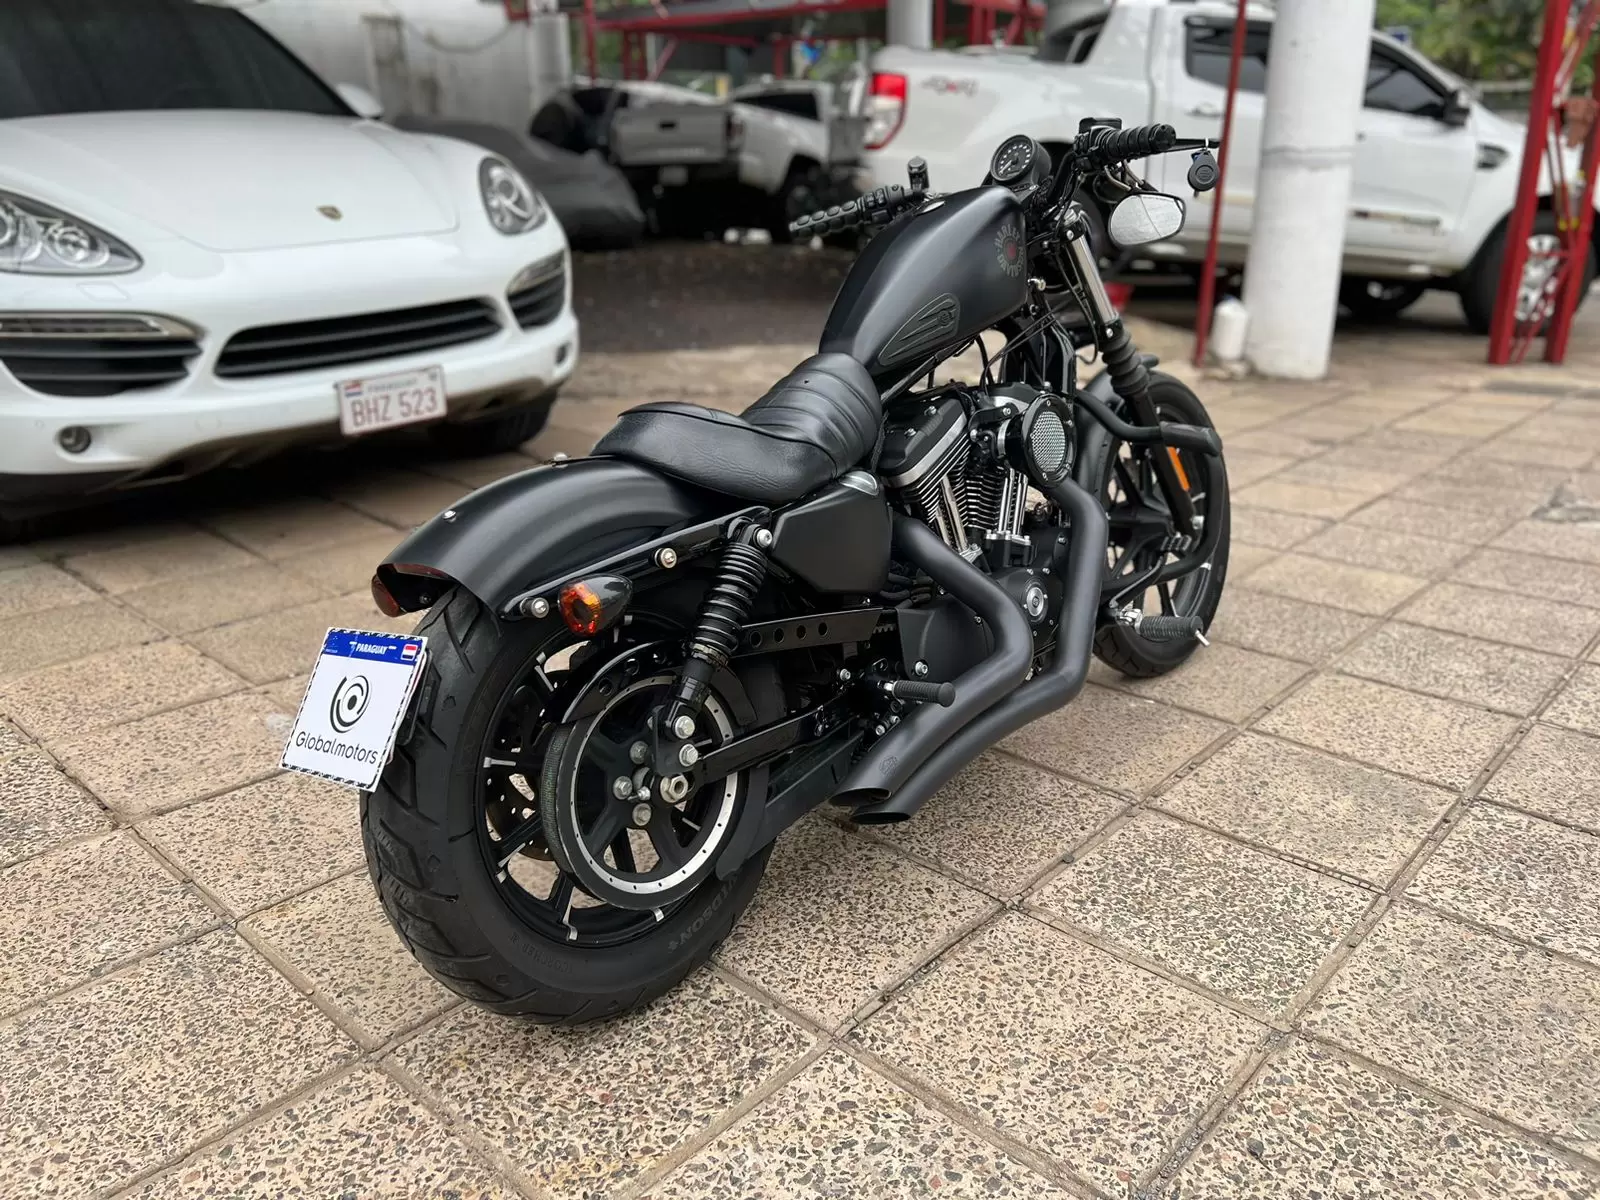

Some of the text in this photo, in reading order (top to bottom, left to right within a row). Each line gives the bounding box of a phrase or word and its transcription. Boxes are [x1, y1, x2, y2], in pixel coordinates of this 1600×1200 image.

[350, 387, 438, 427] BHZ 523
[355, 642, 388, 656] PARAGUAY
[295, 731, 379, 765] Globalmotors
